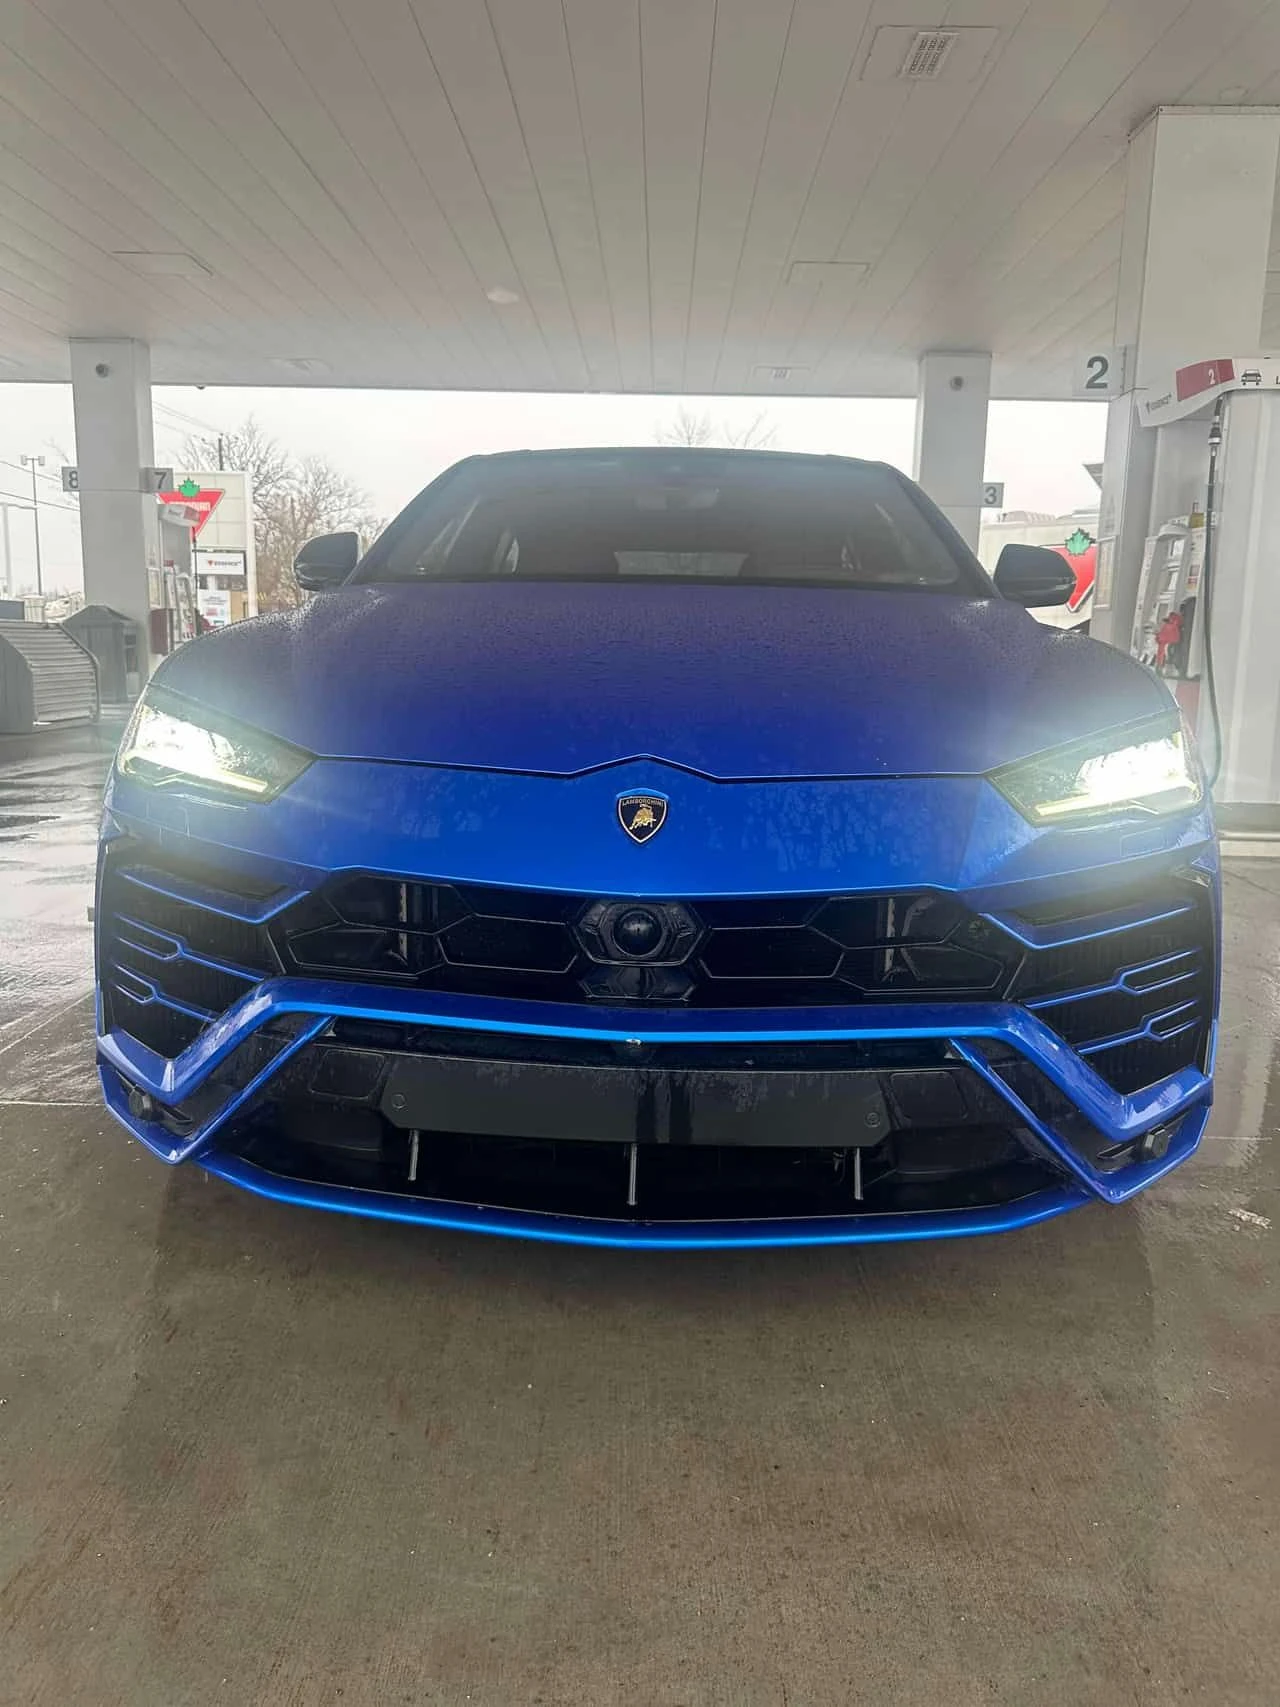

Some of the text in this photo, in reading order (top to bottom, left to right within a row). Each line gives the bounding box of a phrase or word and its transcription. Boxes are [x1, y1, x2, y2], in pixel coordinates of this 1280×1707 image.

[1086, 356, 1109, 389] 2
[1208, 369, 1216, 385] 2
[68, 470, 79, 489] 8
[154, 471, 167, 489] 7
[984, 486, 997, 505] 3
[622, 798, 664, 807] LAMBORGHINI
